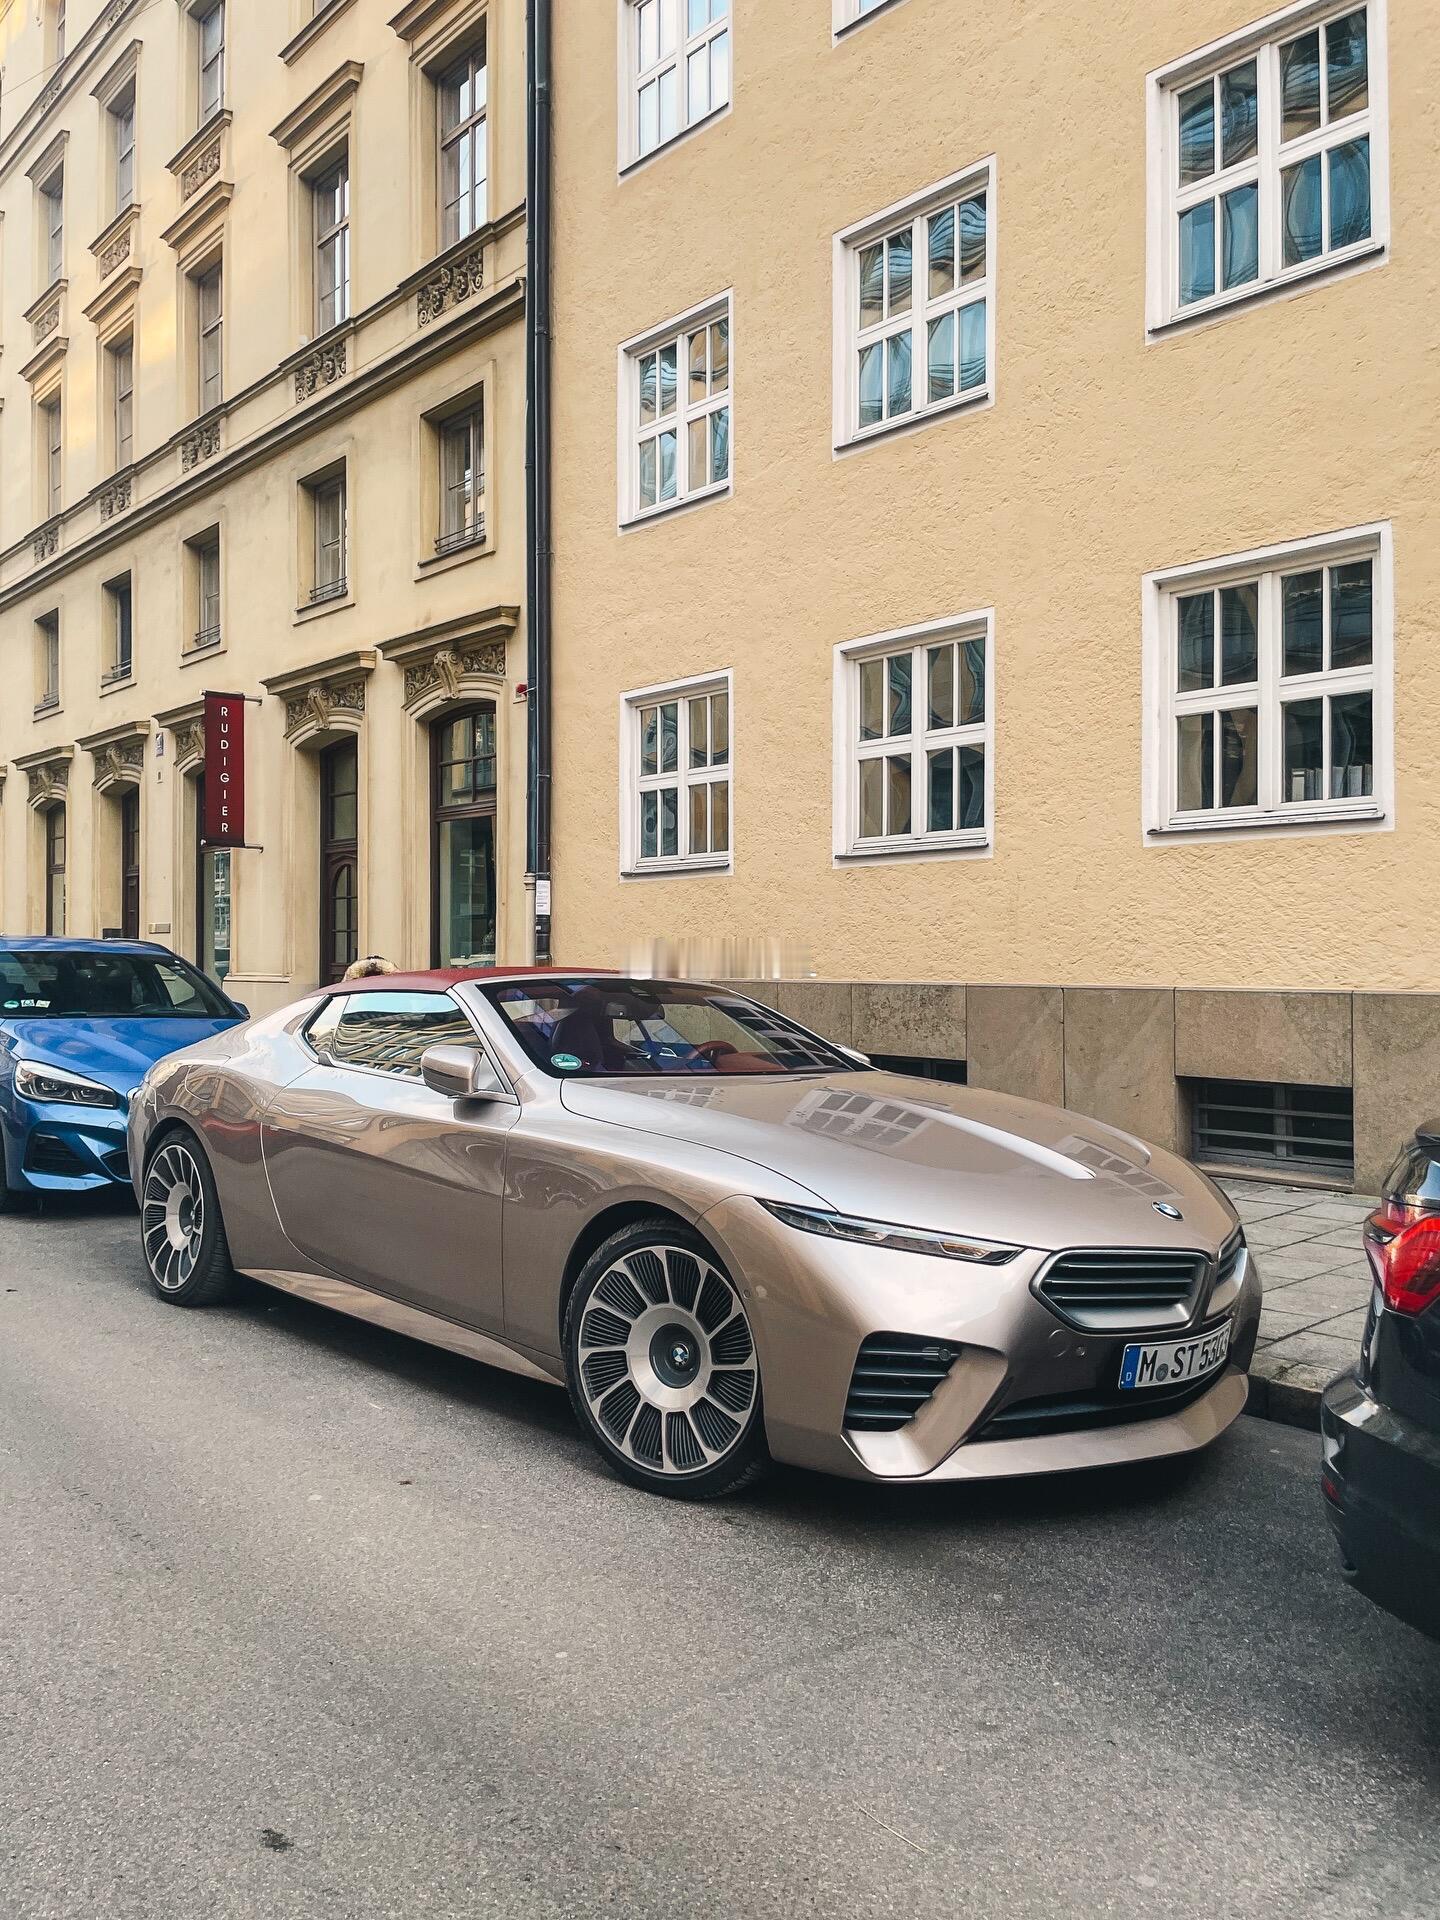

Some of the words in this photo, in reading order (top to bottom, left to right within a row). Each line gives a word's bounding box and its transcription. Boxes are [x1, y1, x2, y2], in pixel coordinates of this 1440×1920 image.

[220, 706, 230, 833] RUDIGIER
[1125, 1371, 1133, 1382] D
[1138, 1349, 1158, 1382] M
[1170, 1342, 1200, 1378] ST
